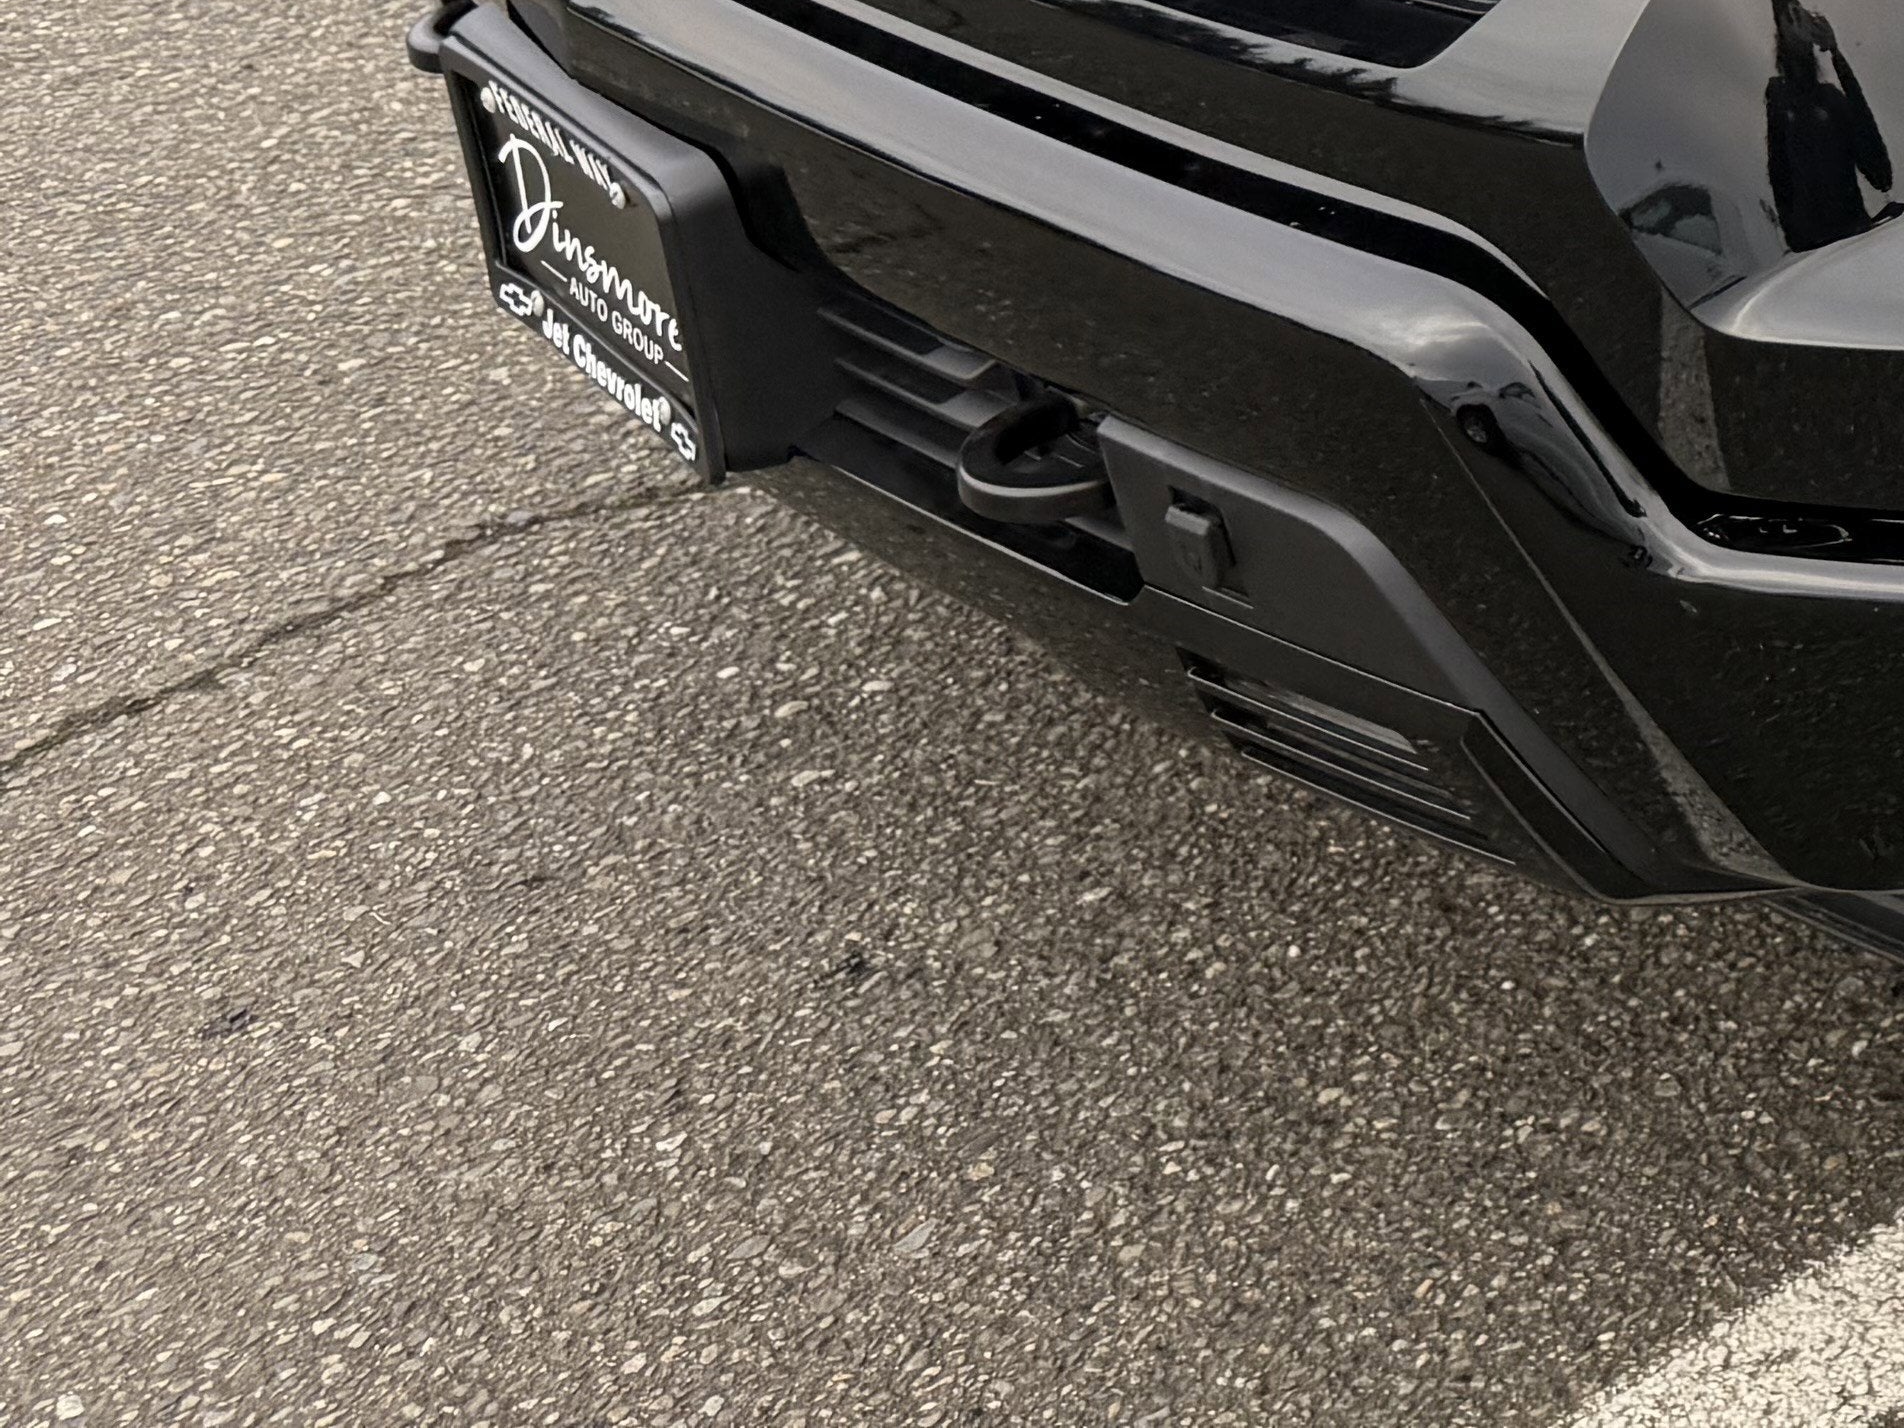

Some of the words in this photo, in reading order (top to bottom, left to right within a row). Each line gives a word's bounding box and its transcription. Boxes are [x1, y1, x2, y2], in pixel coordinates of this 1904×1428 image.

[488, 80, 575, 166] FEDERAL
[498, 134, 683, 352] Dinsmore
[542, 308, 571, 347] Jet
[573, 333, 662, 434] Chevrolet
[569, 276, 609, 323] AUTO
[611, 310, 666, 366] GROUP
